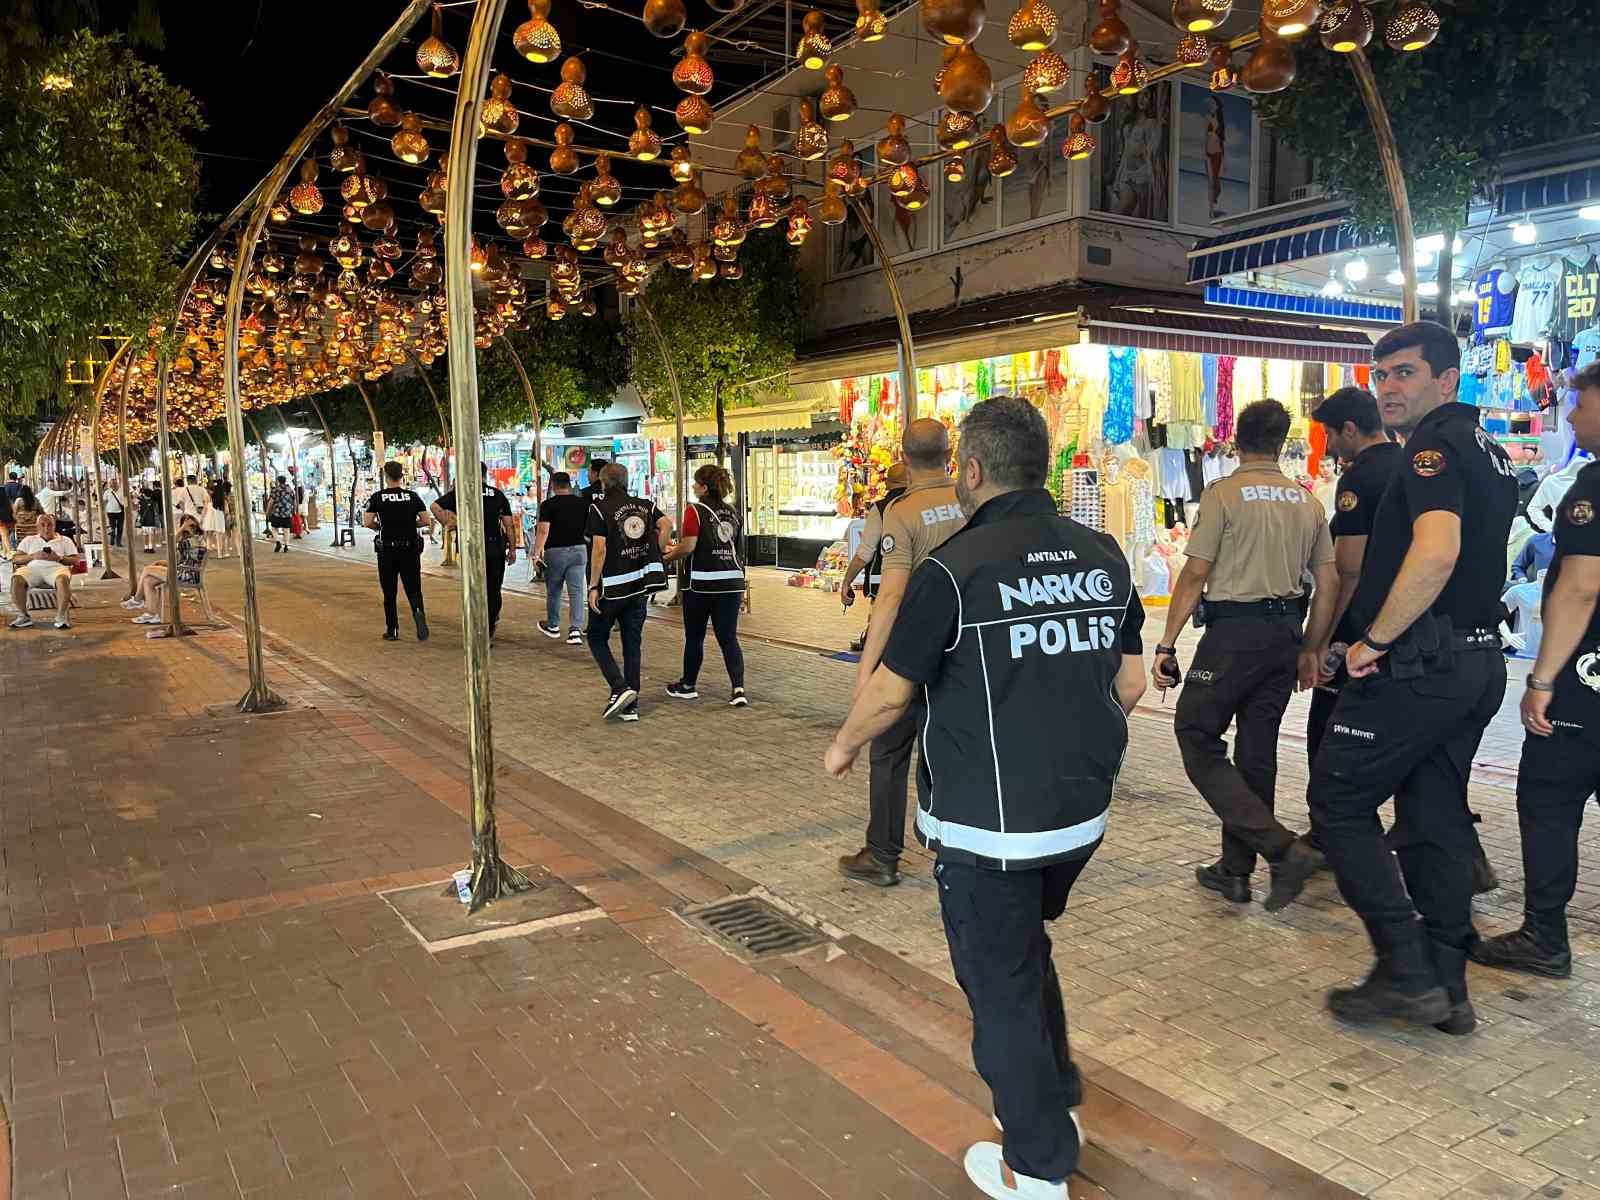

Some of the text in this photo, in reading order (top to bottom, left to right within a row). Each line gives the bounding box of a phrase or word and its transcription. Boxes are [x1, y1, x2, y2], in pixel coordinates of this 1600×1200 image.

[1565, 273, 1599, 297] CLT
[1532, 291, 1549, 305] 77
[1567, 297, 1596, 318] 20
[921, 503, 963, 526] BEK
[1027, 550, 1077, 563] ANTALYA
[998, 568, 1113, 611] NARKO
